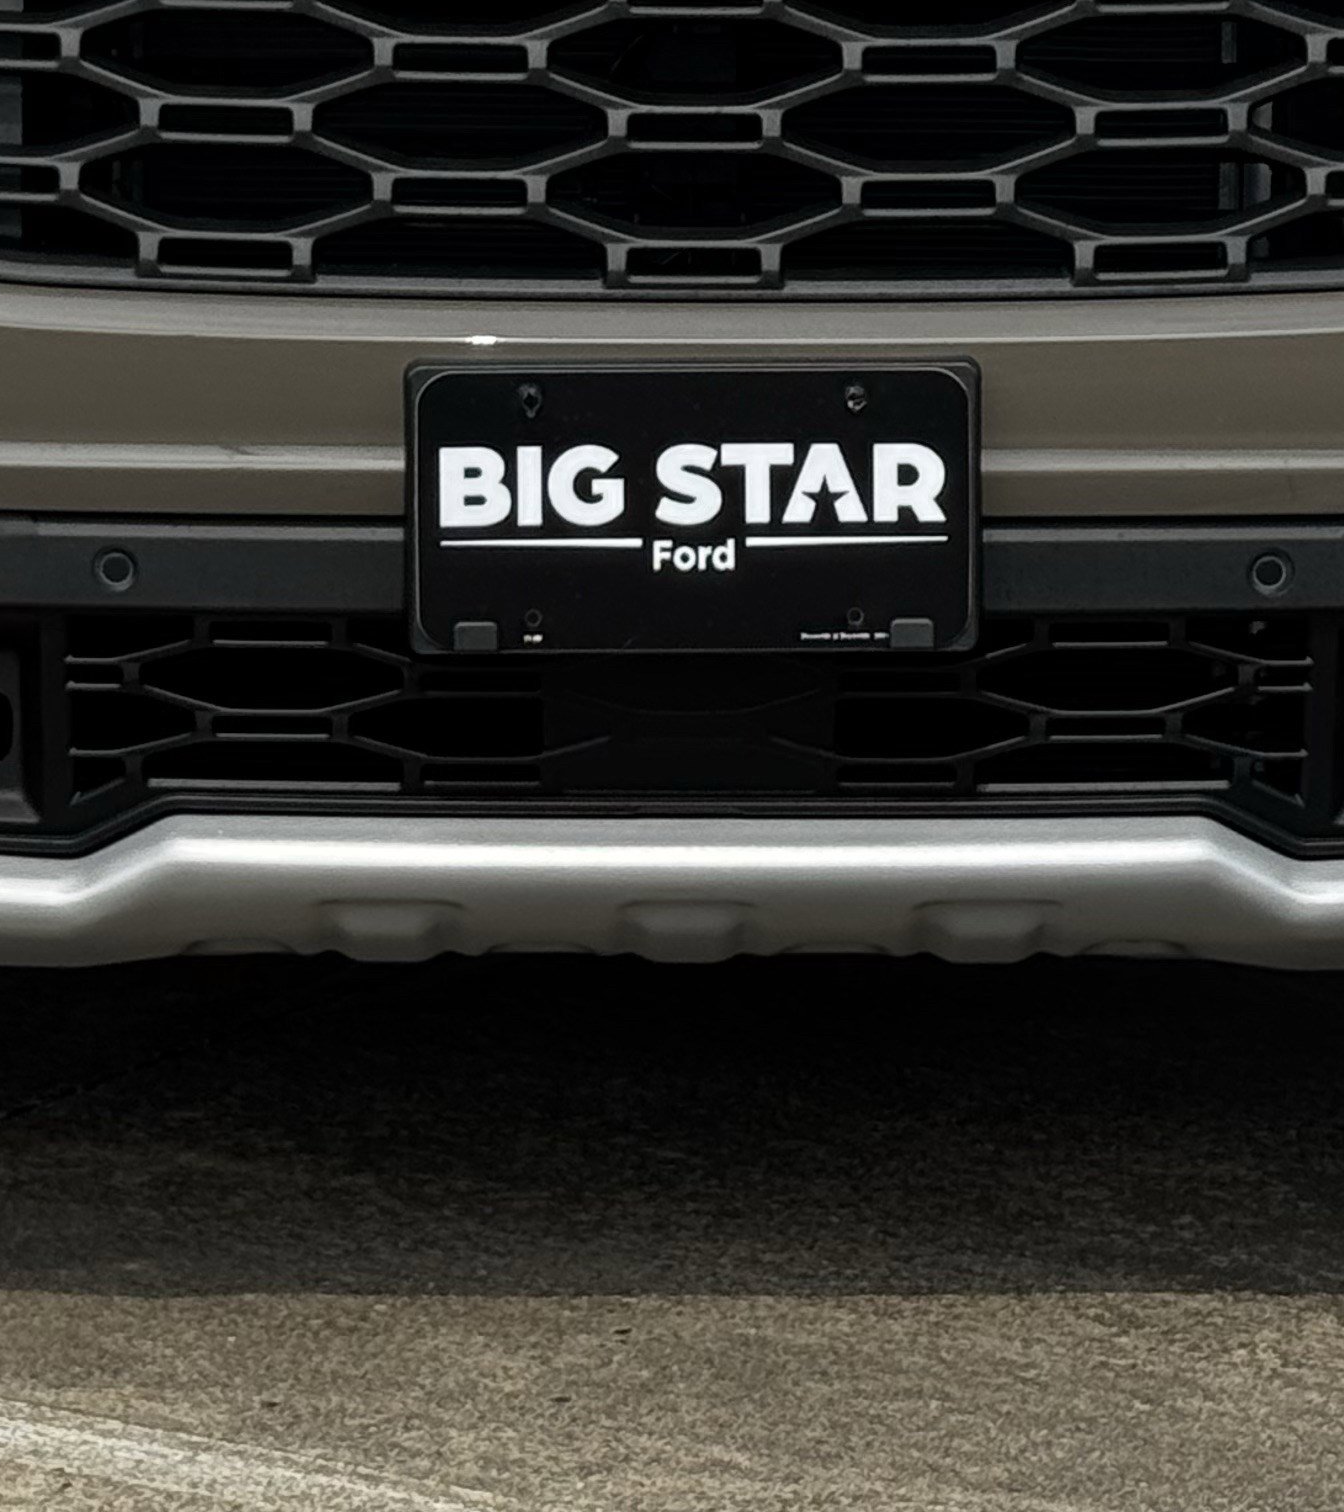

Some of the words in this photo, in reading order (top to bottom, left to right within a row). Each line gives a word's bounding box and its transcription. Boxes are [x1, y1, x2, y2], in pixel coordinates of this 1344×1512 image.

[438, 444, 625, 528] BIG
[655, 442, 947, 526] STAR
[652, 538, 736, 571] Ford
